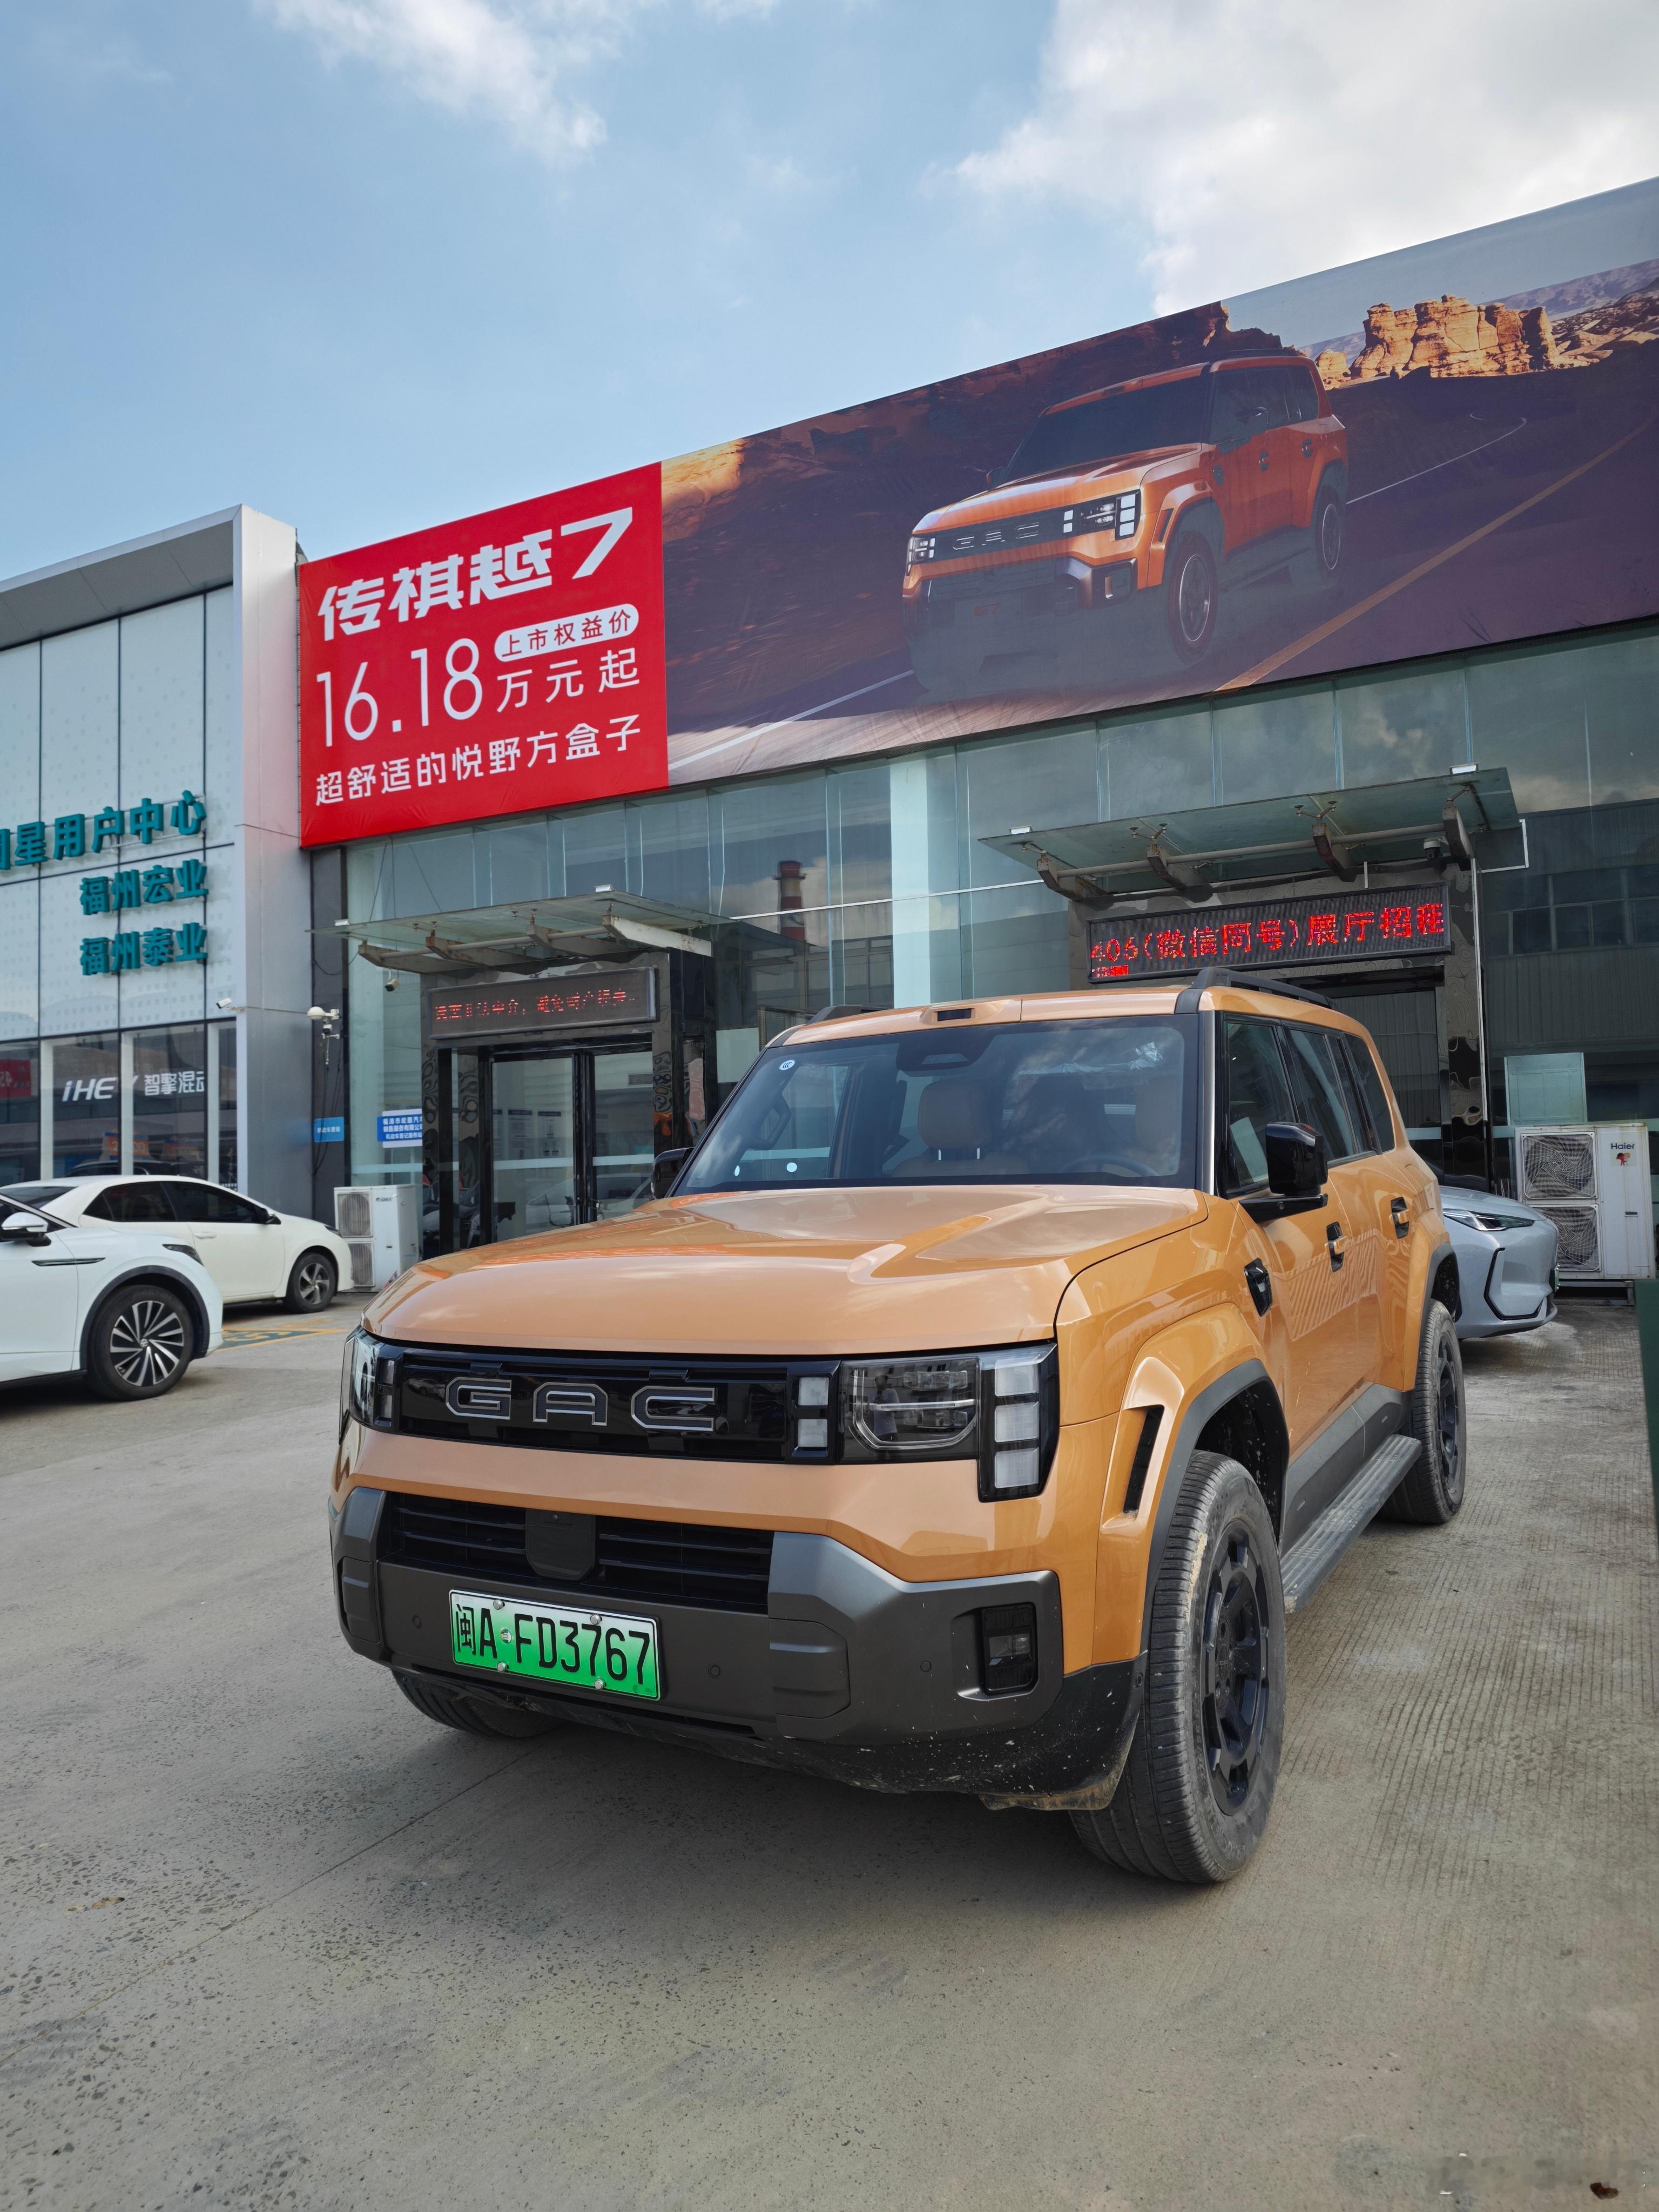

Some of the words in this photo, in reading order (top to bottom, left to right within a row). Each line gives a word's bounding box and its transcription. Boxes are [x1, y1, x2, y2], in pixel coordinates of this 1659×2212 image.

[318, 507, 633, 642] 传祺越7
[501, 608, 631, 657] 上市权益价
[315, 713, 640, 806] 超舒适的悦野方盒子
[79, 859, 209, 915] 福州宏业
[79, 922, 208, 976] 福州泰业
[446, 1376, 716, 1433] GAC
